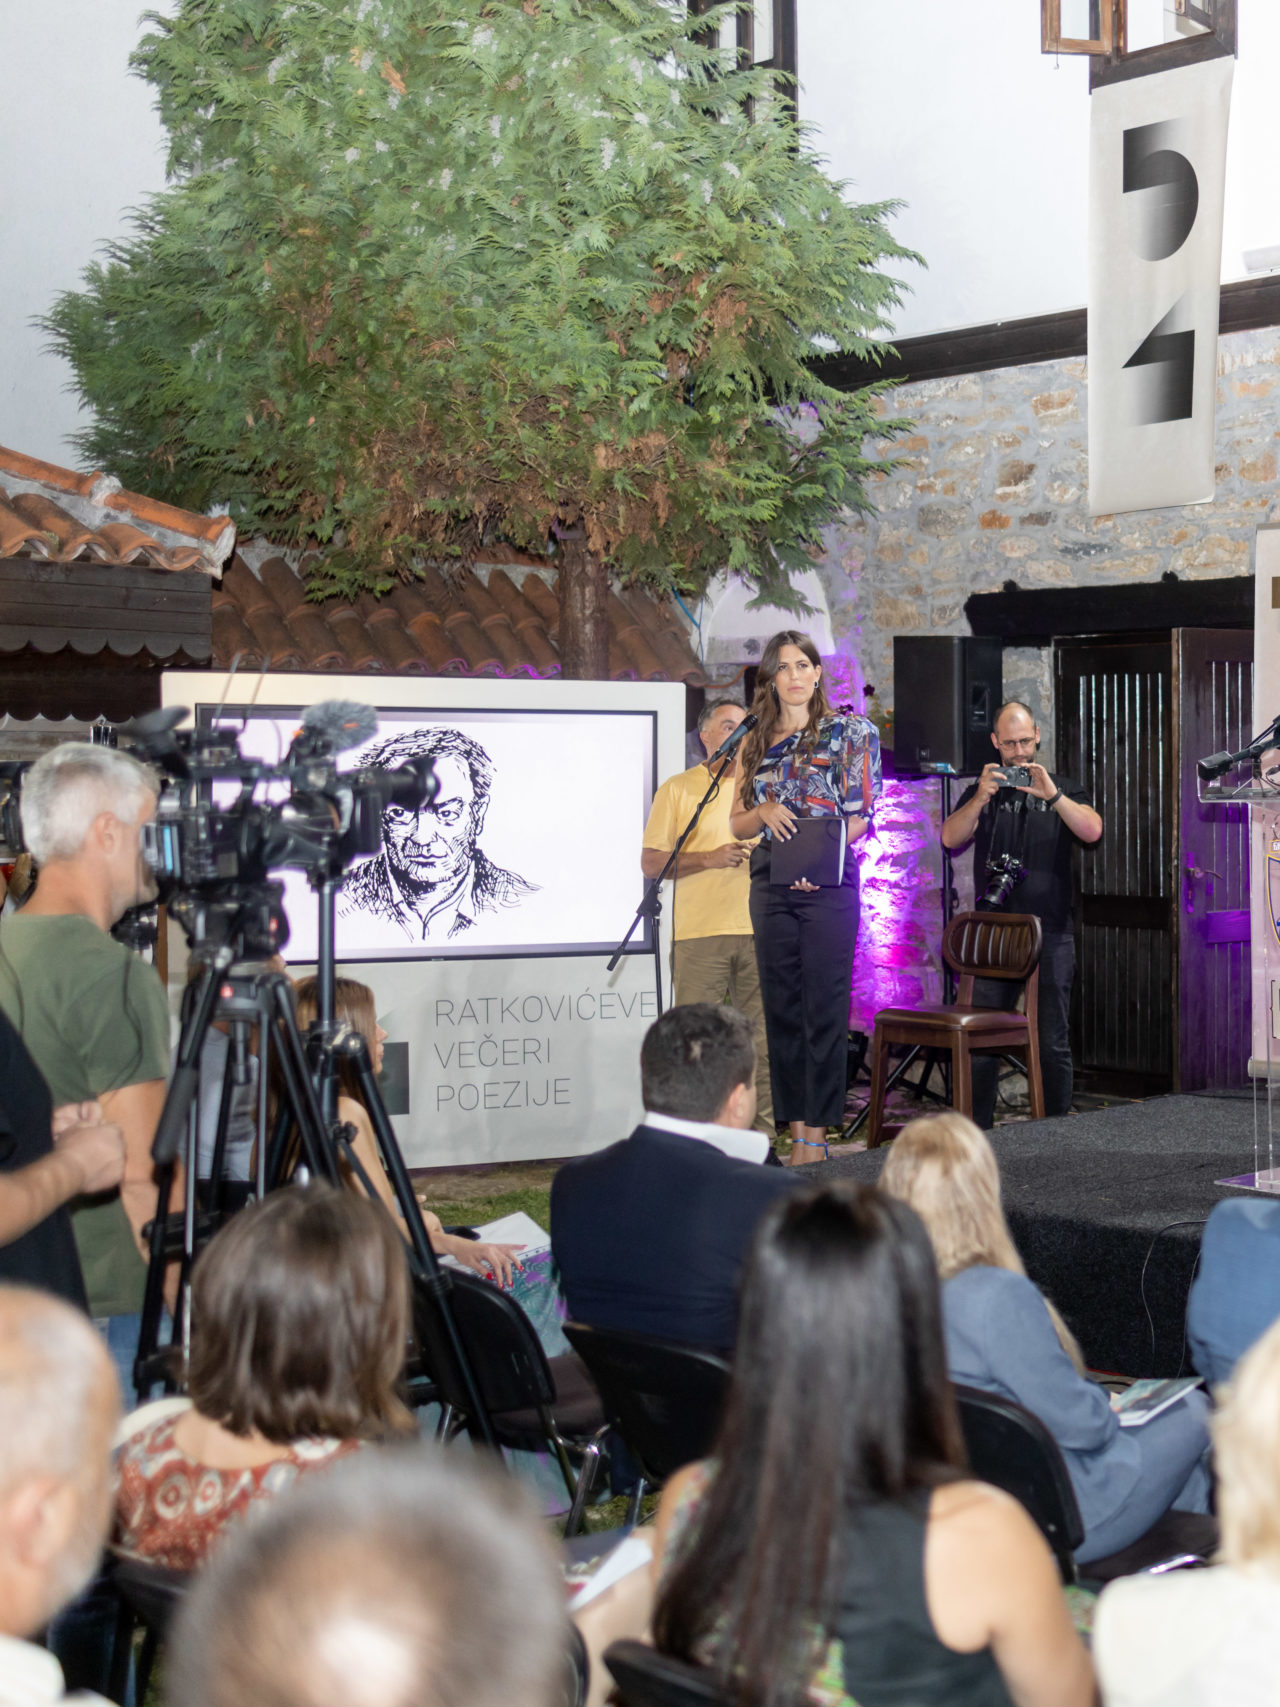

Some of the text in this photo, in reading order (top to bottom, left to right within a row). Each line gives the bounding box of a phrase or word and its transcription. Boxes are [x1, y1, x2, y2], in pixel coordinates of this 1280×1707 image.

[435, 987, 657, 1027] RATKOVIĆEVE
[434, 1033, 551, 1069] VEČERI
[436, 1078, 571, 1113] POEZIJE
